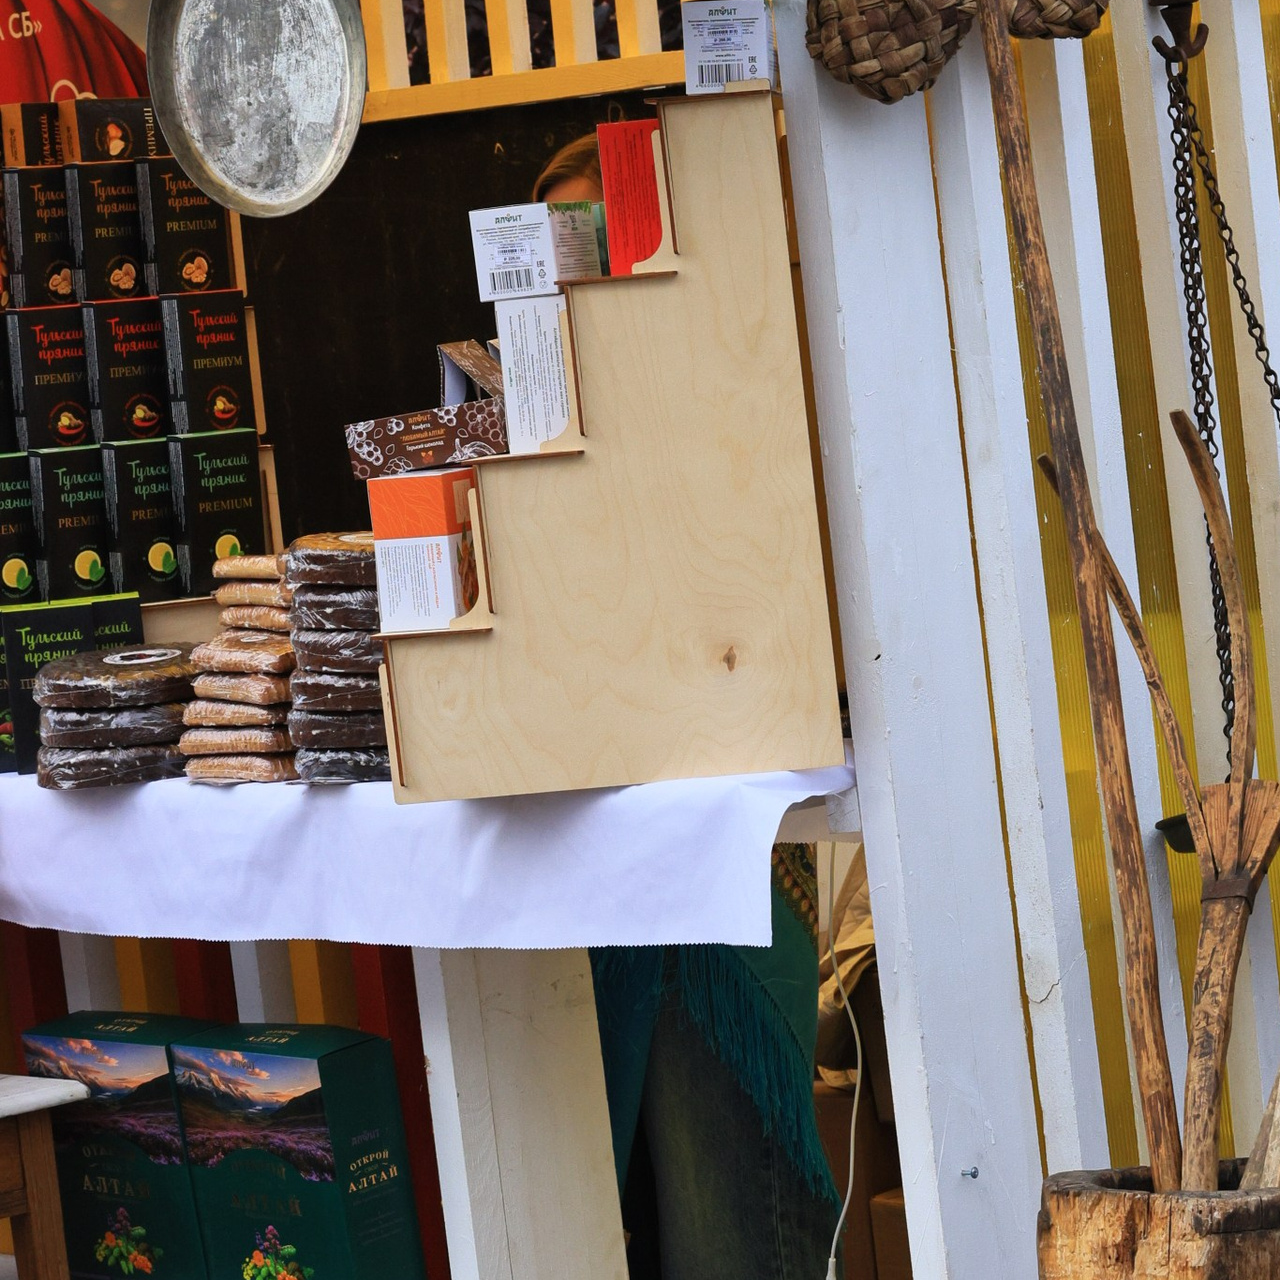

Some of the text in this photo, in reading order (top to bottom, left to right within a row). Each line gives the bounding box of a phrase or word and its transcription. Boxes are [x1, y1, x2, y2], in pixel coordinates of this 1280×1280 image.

[143, 107, 157, 157] ПРЕМИУ
[29, 183, 66, 207] Тульск
[89, 179, 137, 202] Тульски
[161, 174, 197, 195] Тульс
[36, 206, 67, 224] прян
[166, 219, 217, 232] PREMIUM
[188, 309, 239, 331] Тульский
[30, 324, 84, 348] Тульски
[195, 331, 236, 350] пряник
[113, 339, 159, 360] пряник
[193, 355, 243, 370] ПРЕМИУМ
[34, 371, 83, 386] ПРЕМИУ
[126, 460, 169, 483] Тульск
[193, 452, 250, 476] Тульский
[53, 467, 103, 490] Тульски
[201, 473, 247, 493] пряник
[198, 497, 253, 514] PREMIUM
[15, 626, 84, 651] Тульский
[349, 1149, 390, 1172] ОТКРОЙ
[347, 1164, 399, 1194] АЛТАЙ
